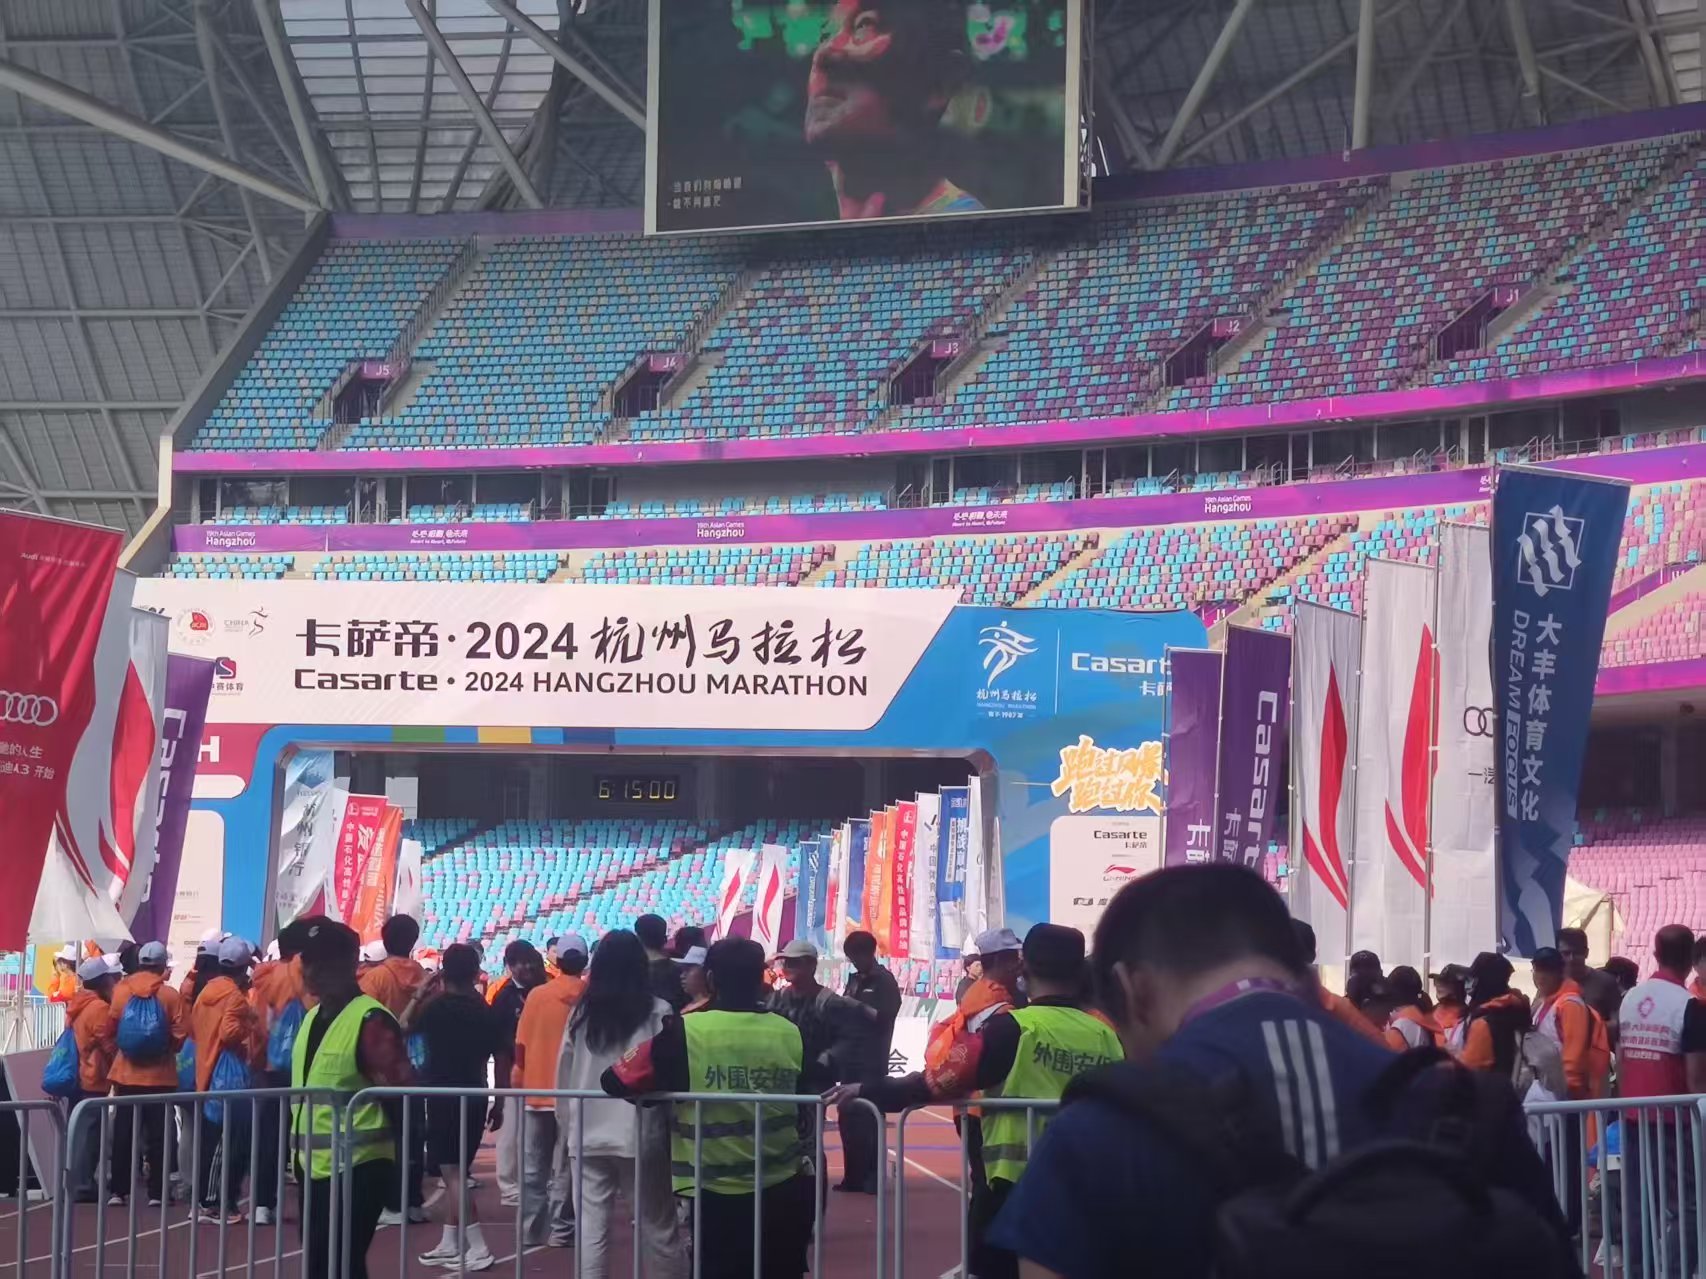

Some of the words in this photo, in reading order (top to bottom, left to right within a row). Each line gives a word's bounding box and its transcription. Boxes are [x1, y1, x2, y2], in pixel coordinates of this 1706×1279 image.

[944, 342, 959, 354] J3
[375, 364, 390, 376] J5
[1204, 502, 1252, 514] Hangzhou
[696, 528, 745, 539] Hangzhou
[205, 536, 256, 548] Hangzhou
[21, 552, 38, 561] Audi
[465, 621, 579, 660] 2024
[590, 613, 868, 669] 杭州马拉松
[1071, 652, 1171, 675] Casart
[294, 668, 438, 691] Casarte
[465, 671, 524, 692] 2024
[533, 671, 696, 694] HANGZHOU
[706, 674, 868, 696] MARATHON
[976, 688, 1037, 701] 杭州马拉松
[1521, 613, 1562, 821] 大丰体育文化
[1094, 830, 1147, 839] Casarte
[705, 1064, 794, 1091] 外围安保
